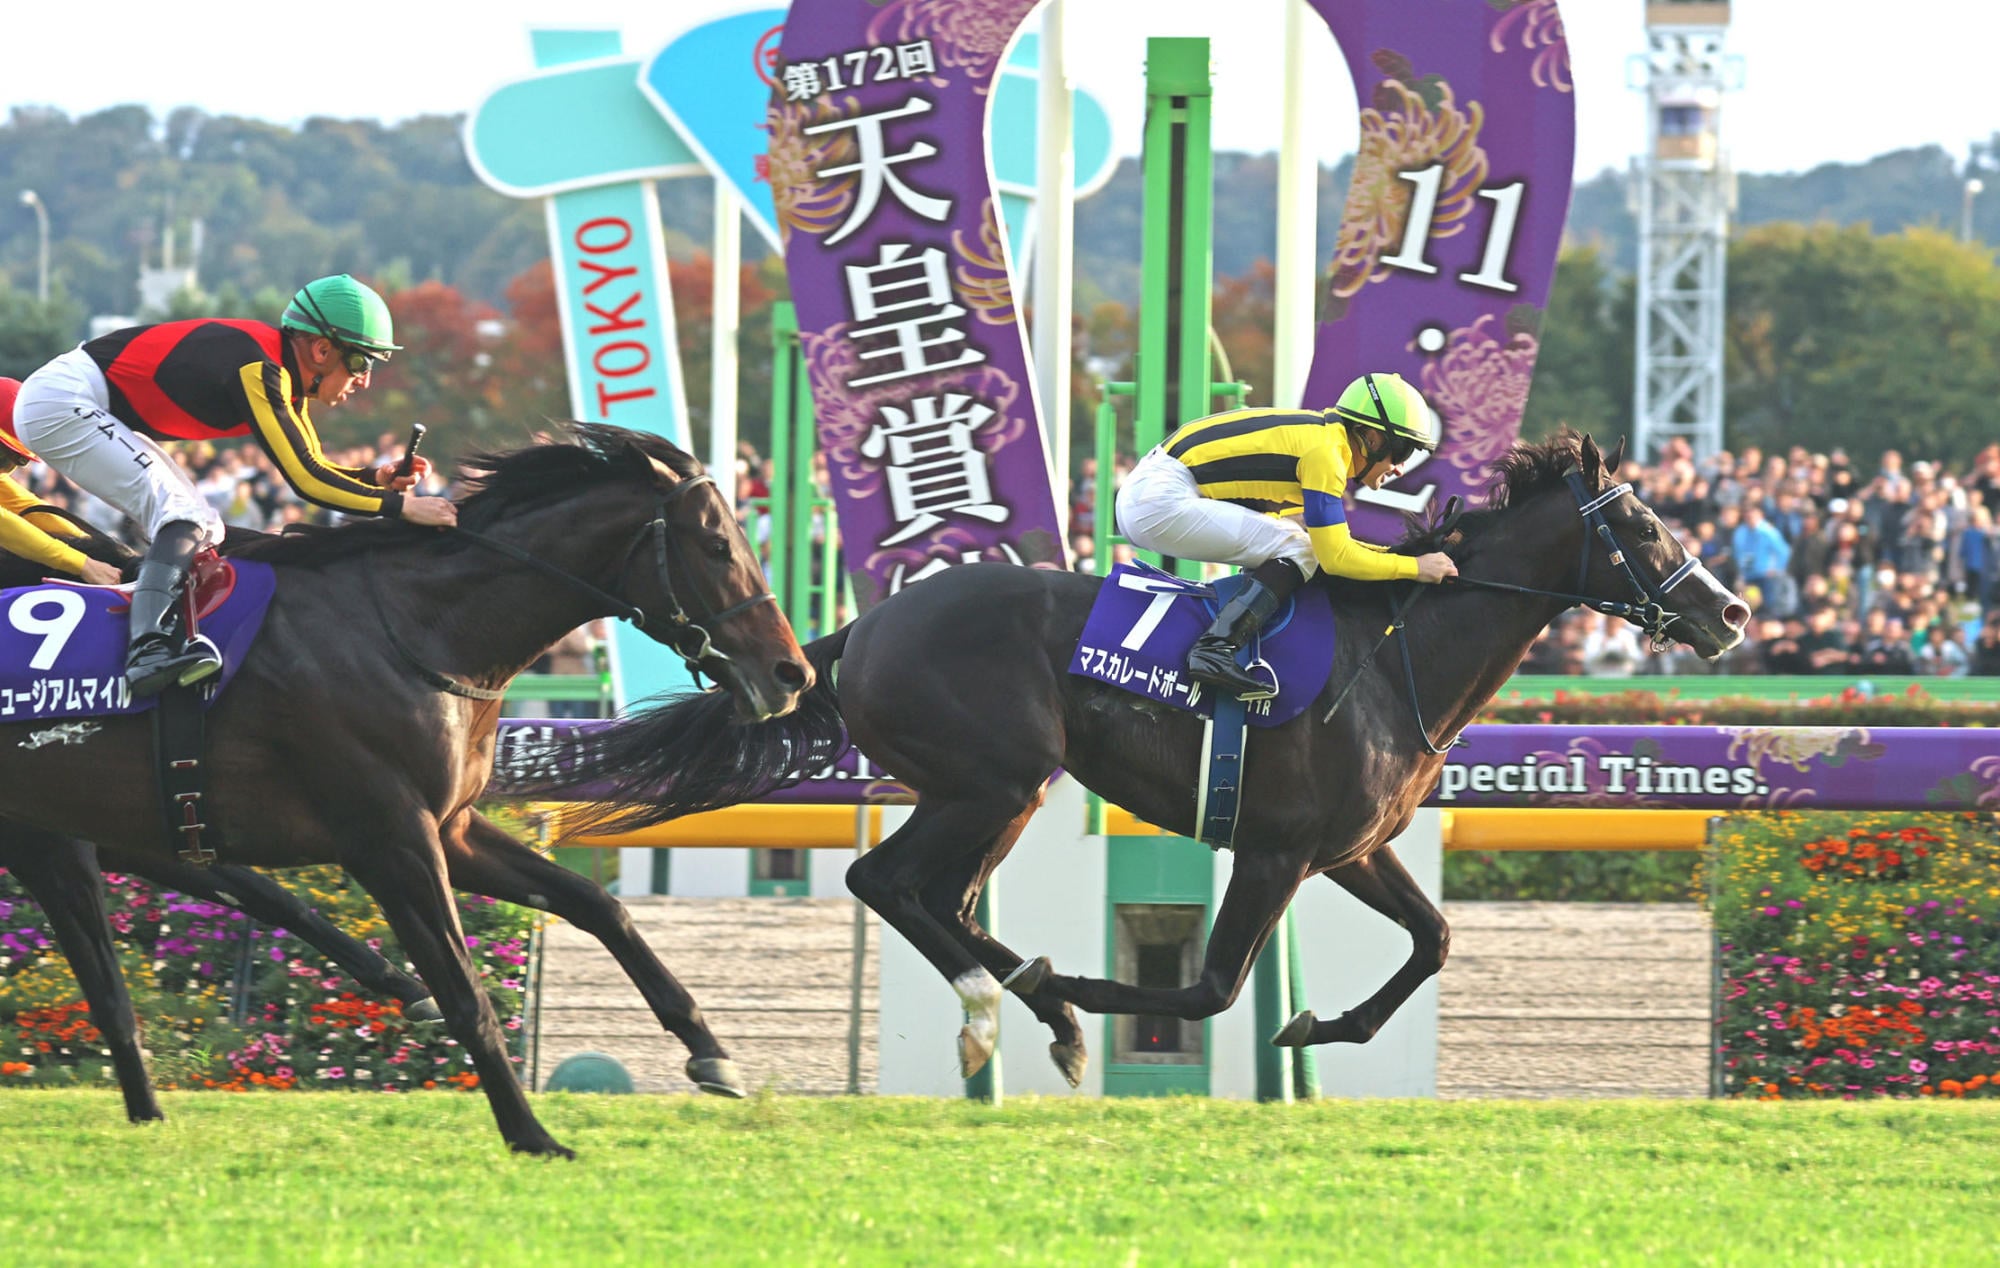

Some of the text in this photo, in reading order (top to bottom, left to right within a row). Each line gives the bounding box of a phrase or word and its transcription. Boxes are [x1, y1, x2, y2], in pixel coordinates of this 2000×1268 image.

[783, 40, 936, 101] 第172回
[574, 216, 656, 418] TOKYO
[803, 97, 1024, 596] 天皇賞
[8, 589, 86, 670] 9
[1118, 573, 1184, 651] 7
[1080, 646, 1201, 707] マスカレードボール
[1435, 755, 1769, 800] pecial Times.
